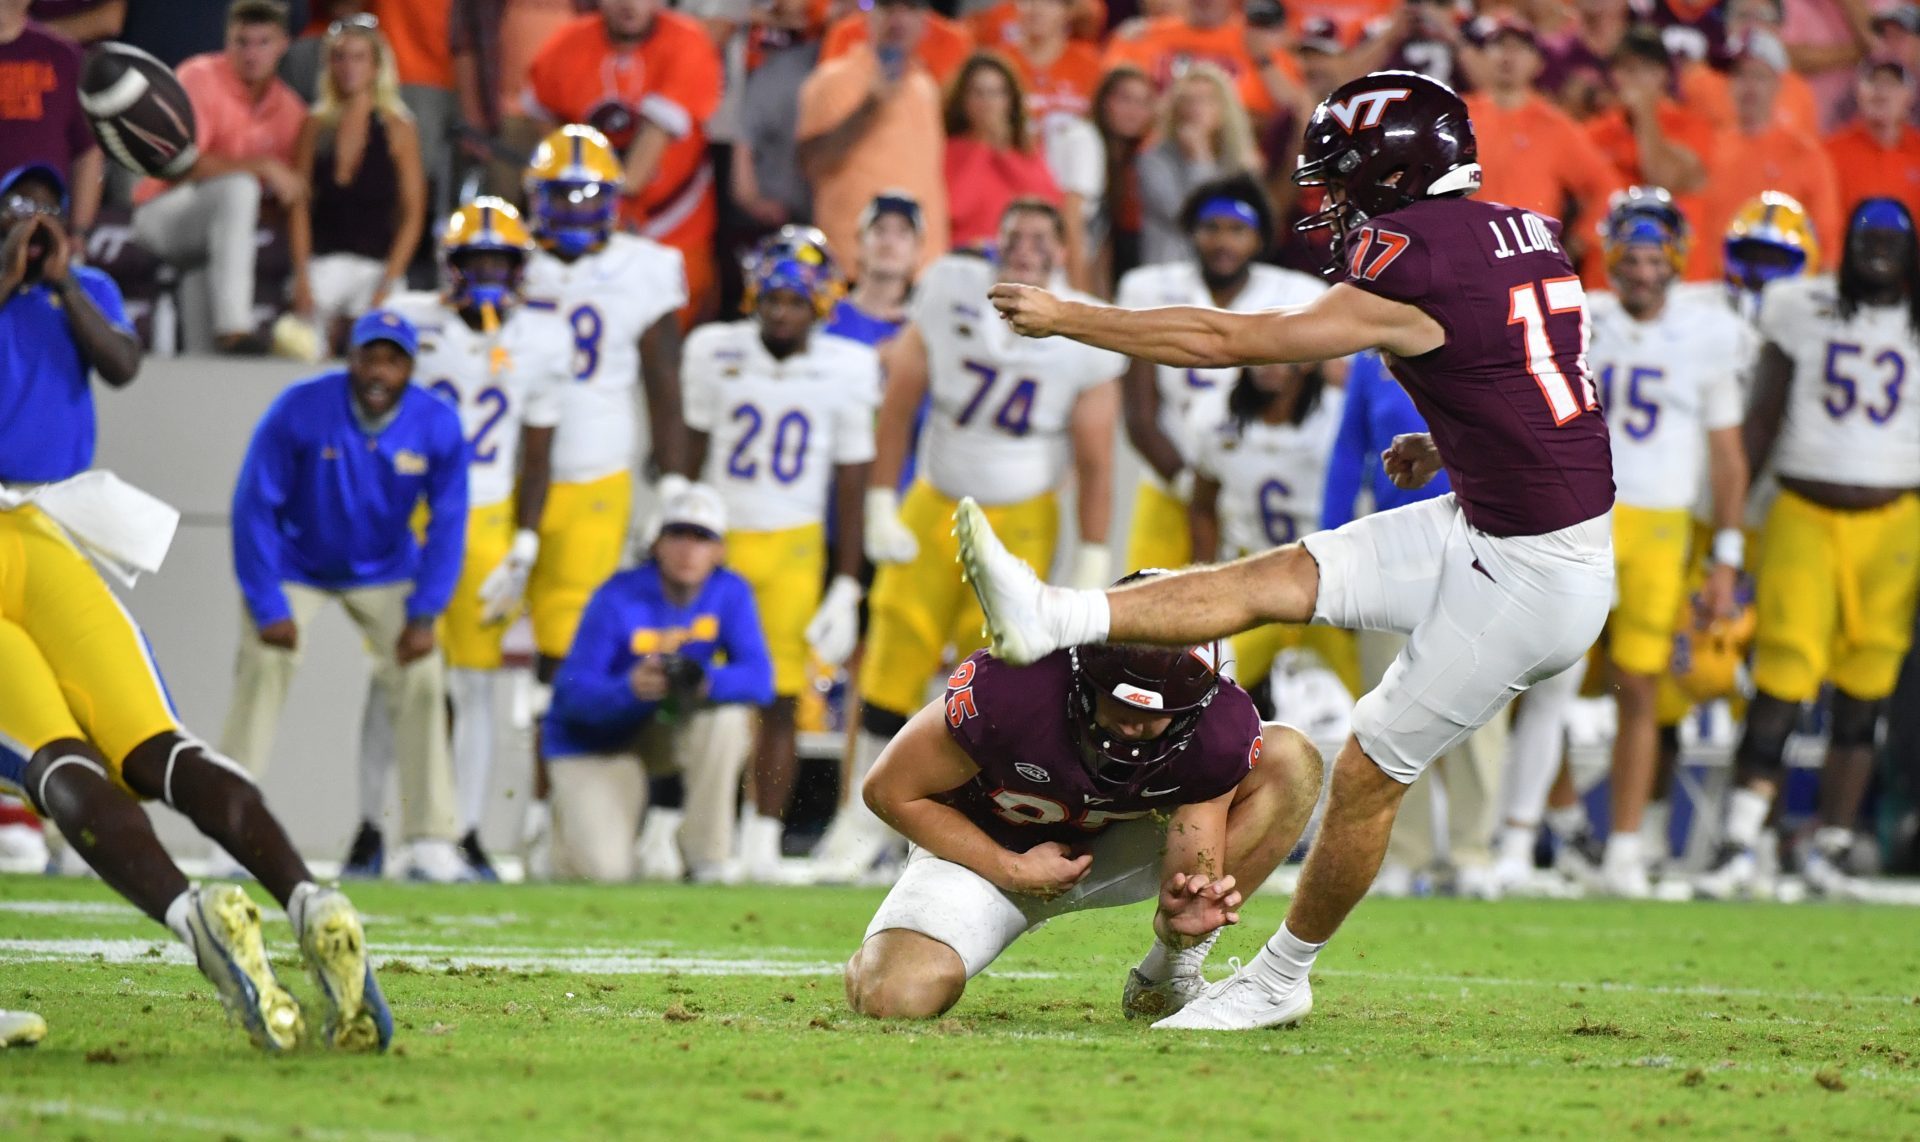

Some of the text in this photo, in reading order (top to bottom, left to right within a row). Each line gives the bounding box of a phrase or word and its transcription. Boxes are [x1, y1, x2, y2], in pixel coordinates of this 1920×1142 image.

[1327, 88, 1412, 135] VT
[1347, 226, 1410, 282] 17
[1507, 274, 1597, 428] 17
[1823, 339, 1907, 425] 53
[430, 378, 509, 463] 2
[960, 359, 1038, 437] 74
[1600, 362, 1664, 442] 15
[727, 402, 811, 484] 20
[1257, 477, 1297, 546] 6
[945, 660, 979, 728] 95
[1123, 692, 1153, 706] ACC
